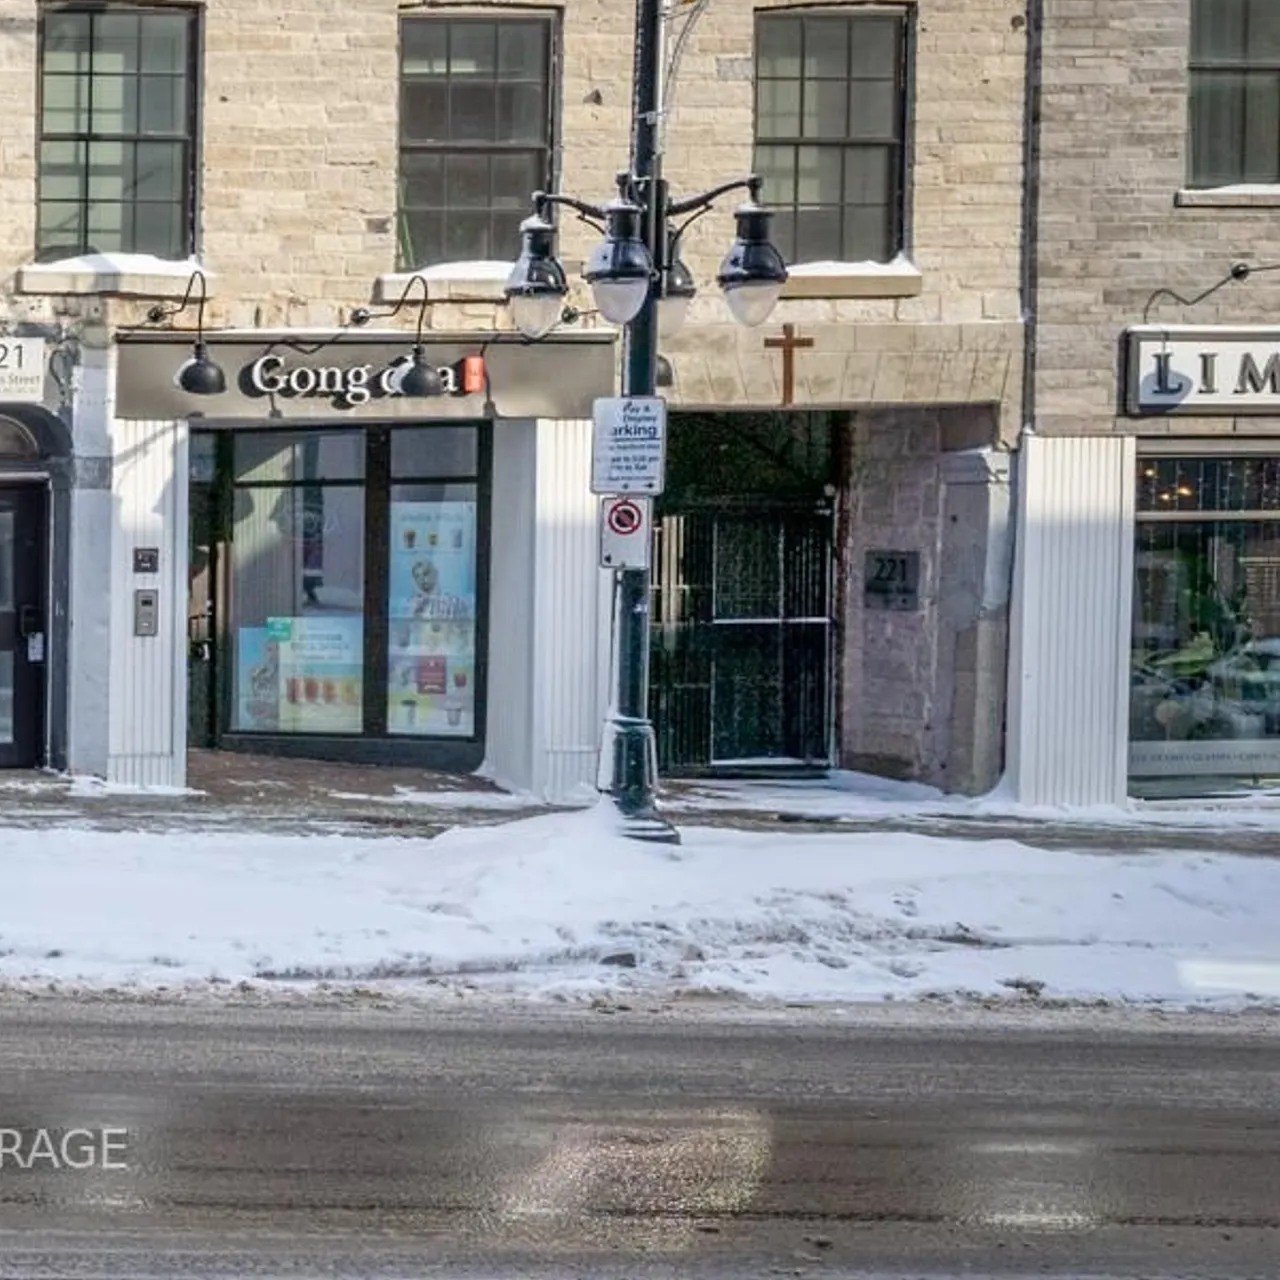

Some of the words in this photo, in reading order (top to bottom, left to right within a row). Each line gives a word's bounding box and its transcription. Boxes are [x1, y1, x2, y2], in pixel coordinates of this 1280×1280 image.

[252, 354, 371, 405] Gong
[381, 360, 458, 393] ca
[610, 424, 657, 439] arking
[873, 559, 907, 582] 221
